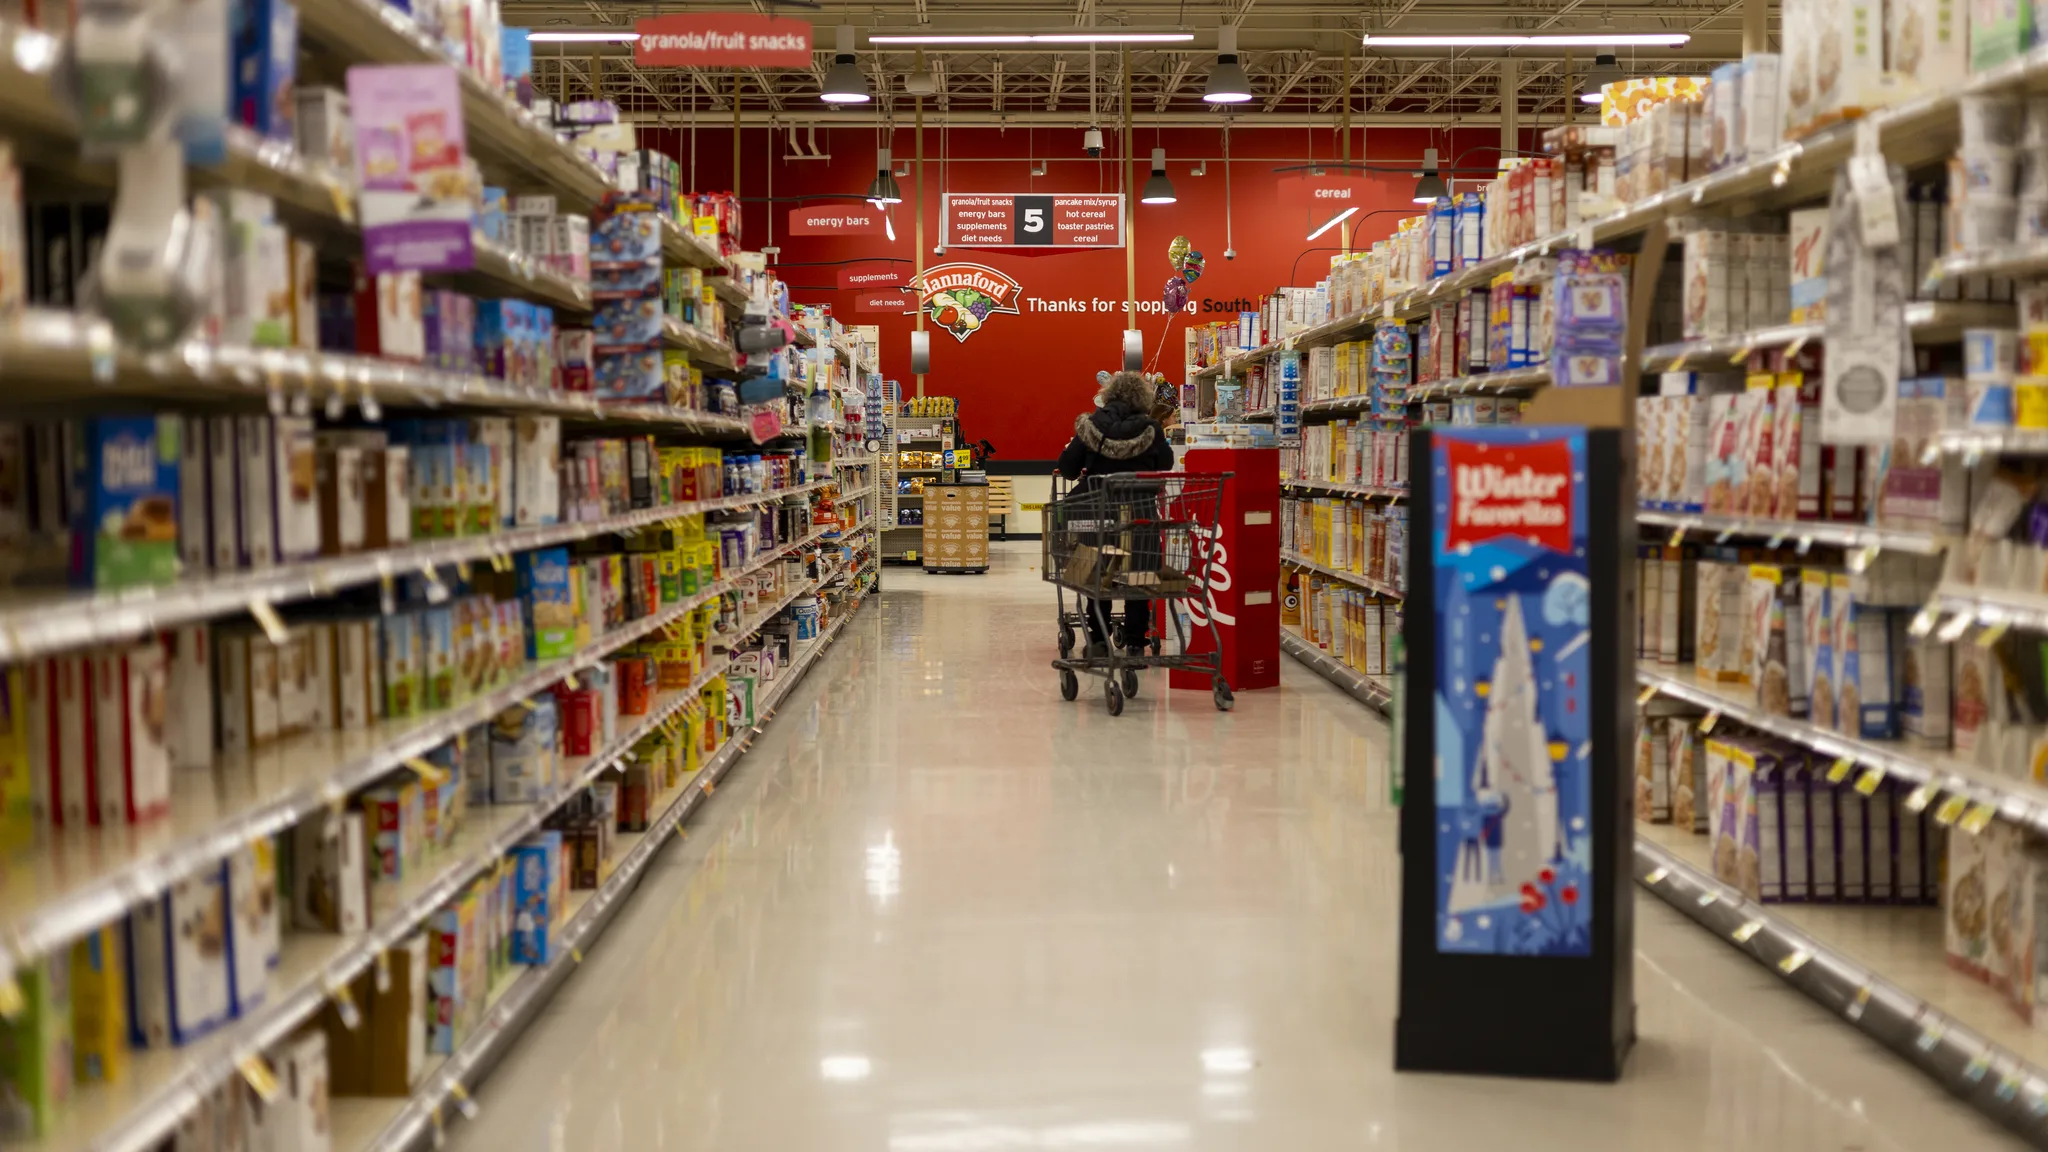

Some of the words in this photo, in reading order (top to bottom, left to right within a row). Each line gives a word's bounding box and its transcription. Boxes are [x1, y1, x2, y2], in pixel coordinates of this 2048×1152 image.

[641, 30, 745, 52] granola/fruit
[749, 32, 806, 50] snacks
[1315, 188, 1351, 199] cereal
[951, 198, 990, 207] granola/fruit
[1055, 198, 1082, 207] pancake
[1084, 198, 1117, 207] mix/syrup
[958, 211, 985, 219] energy
[988, 210, 1006, 218] bars
[1066, 210, 1080, 218] hot
[1081, 210, 1106, 218] cereal
[807, 217, 843, 228] energy
[846, 216, 870, 226] bars
[1023, 208, 1044, 233] 5
[956, 223, 1007, 231] supplements
[1057, 223, 1084, 231] toaster
[1085, 223, 1114, 231] pastries
[961, 234, 977, 242] diet
[978, 234, 1003, 242] needs
[1073, 234, 1098, 242] cereal
[849, 272, 898, 283] supplements
[1027, 297, 1087, 313] Thanks
[1092, 297, 1116, 312] for
[1121, 300, 1197, 315] soppg
[1203, 297, 1252, 312] South
[1457, 463, 1567, 499] Winter
[941, 504, 961, 512] value
[1458, 499, 1566, 526] Favorites
[941, 532, 961, 540] value
[1183, 513, 1236, 627] Post
